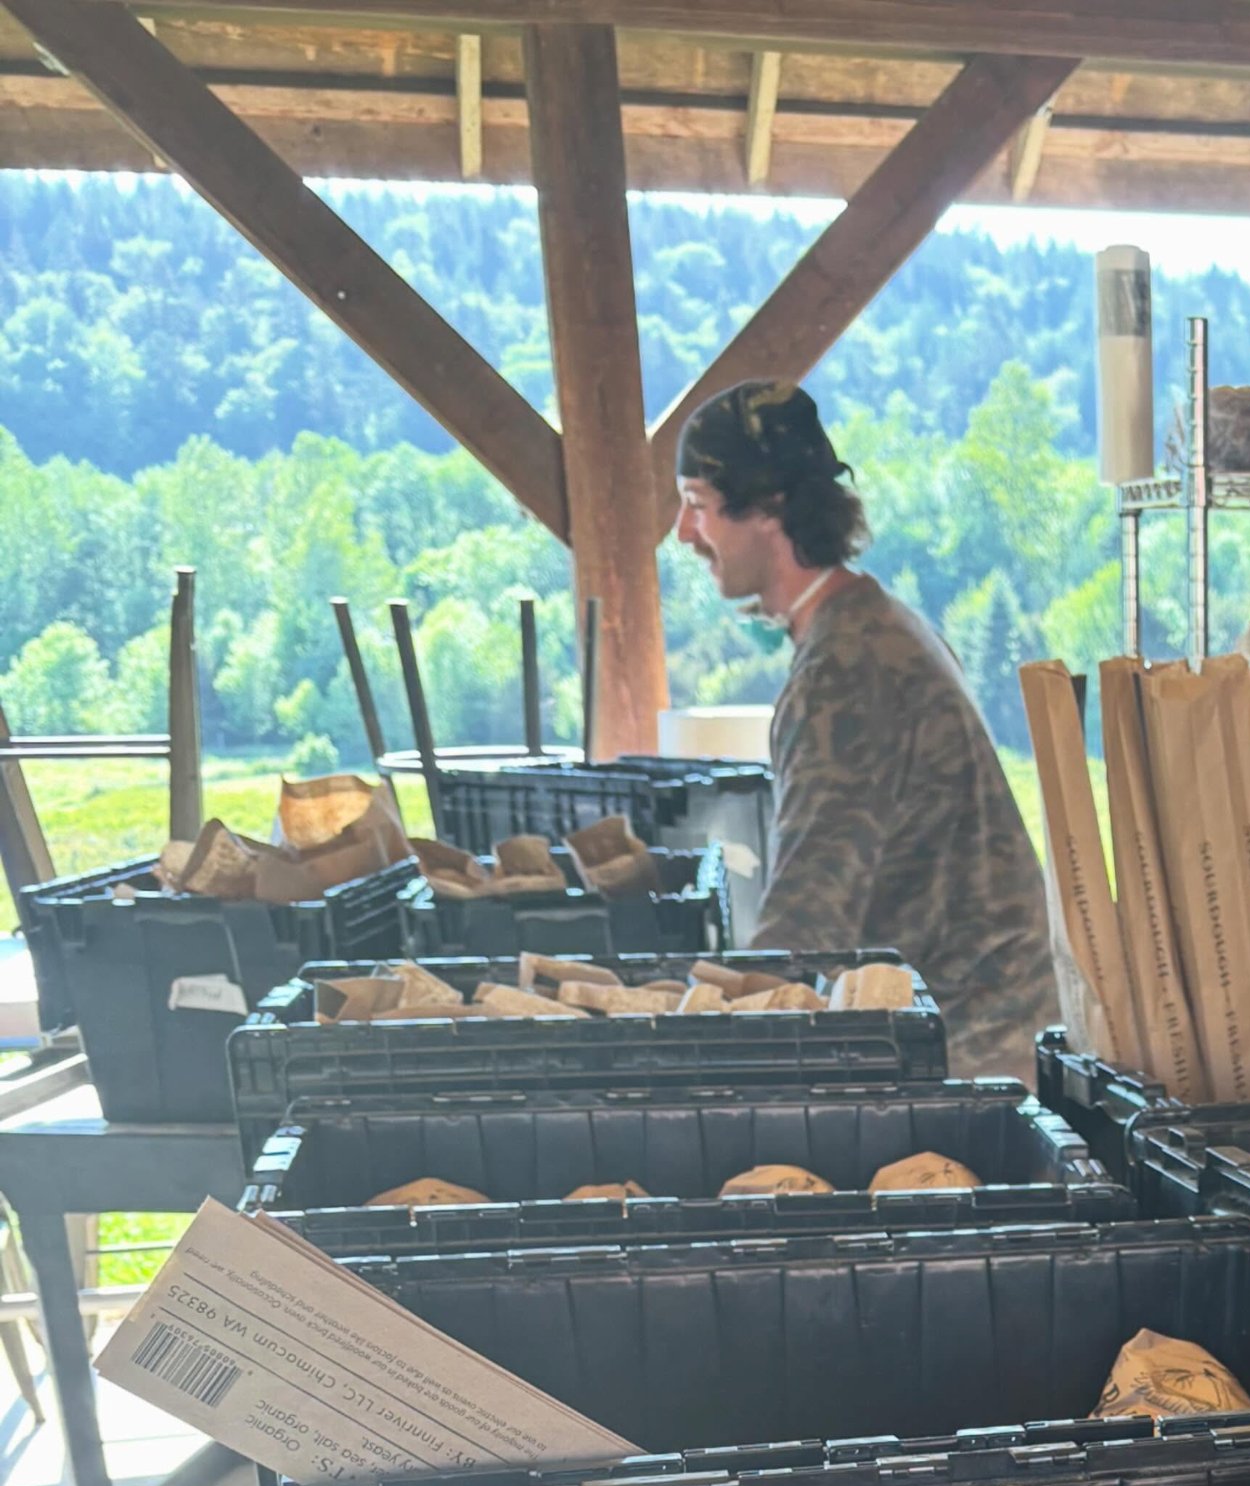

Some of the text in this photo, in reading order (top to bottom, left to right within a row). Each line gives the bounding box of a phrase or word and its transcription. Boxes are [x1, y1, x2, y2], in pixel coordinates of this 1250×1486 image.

[1135, 830, 1169, 979] SOURDOUGH
[1199, 841, 1231, 988] SOURDOUGH
[165, 1283, 219, 1321] 98325
[220, 1314, 248, 1337] WA
[248, 1331, 338, 1390] Chimacum
[326, 1331, 372, 1362] woodfired
[337, 1382, 375, 1411] LLC,
[394, 1372, 424, 1394] baked
[423, 1388, 439, 1401] are
[253, 1396, 311, 1437] organic
[438, 1397, 466, 1418] goods
[242, 1411, 302, 1453] Organic
[310, 1429, 340, 1454] salt,
[374, 1404, 445, 1453] Finnriver
[340, 1446, 367, 1467] sea
[358, 1433, 400, 1464] yeast.
